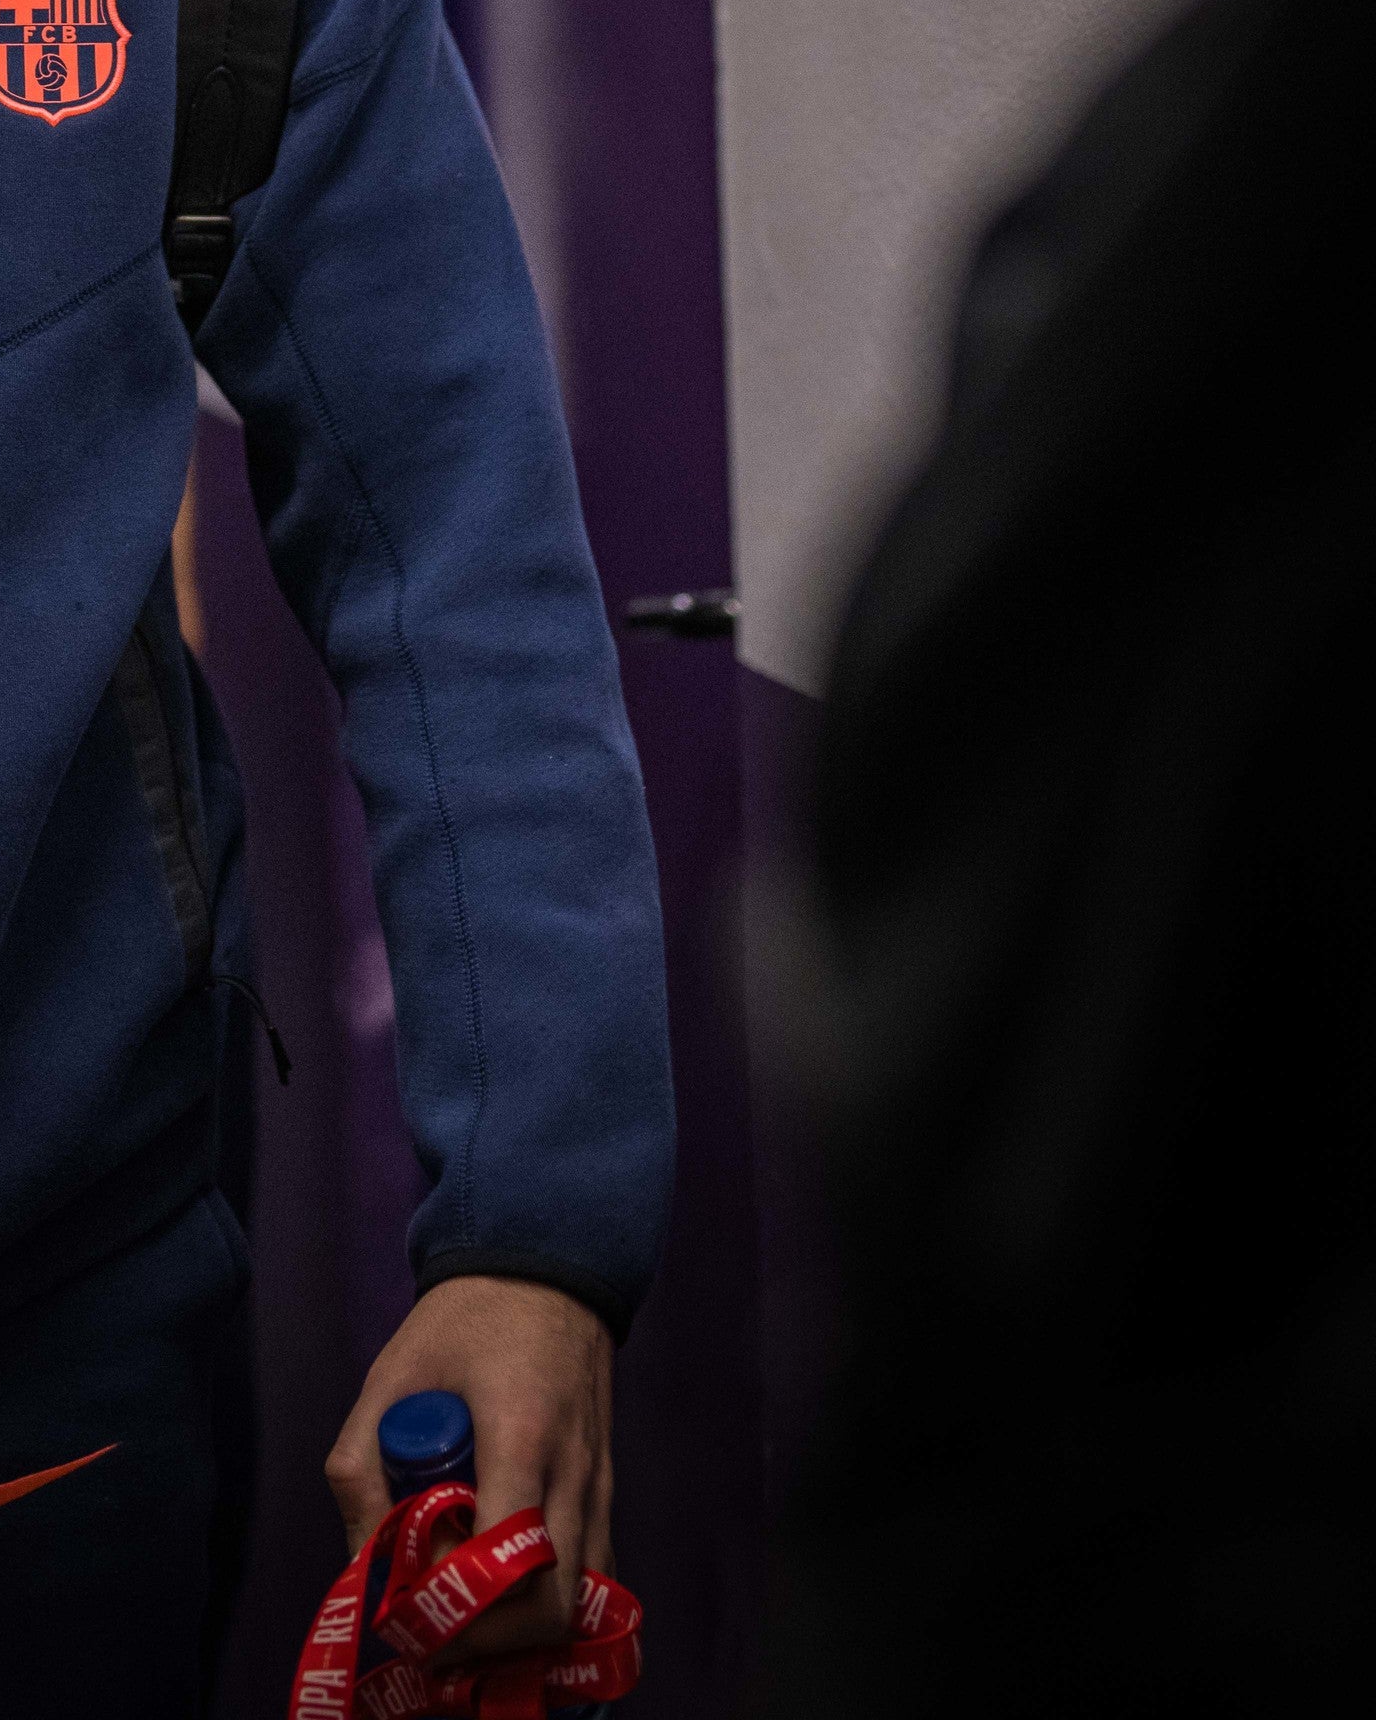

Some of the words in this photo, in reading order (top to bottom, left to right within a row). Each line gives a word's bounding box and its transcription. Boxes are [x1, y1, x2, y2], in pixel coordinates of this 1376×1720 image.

[22, 26, 78, 44] FCB
[312, 1595, 359, 1645] REY
[412, 1562, 479, 1636] REY
